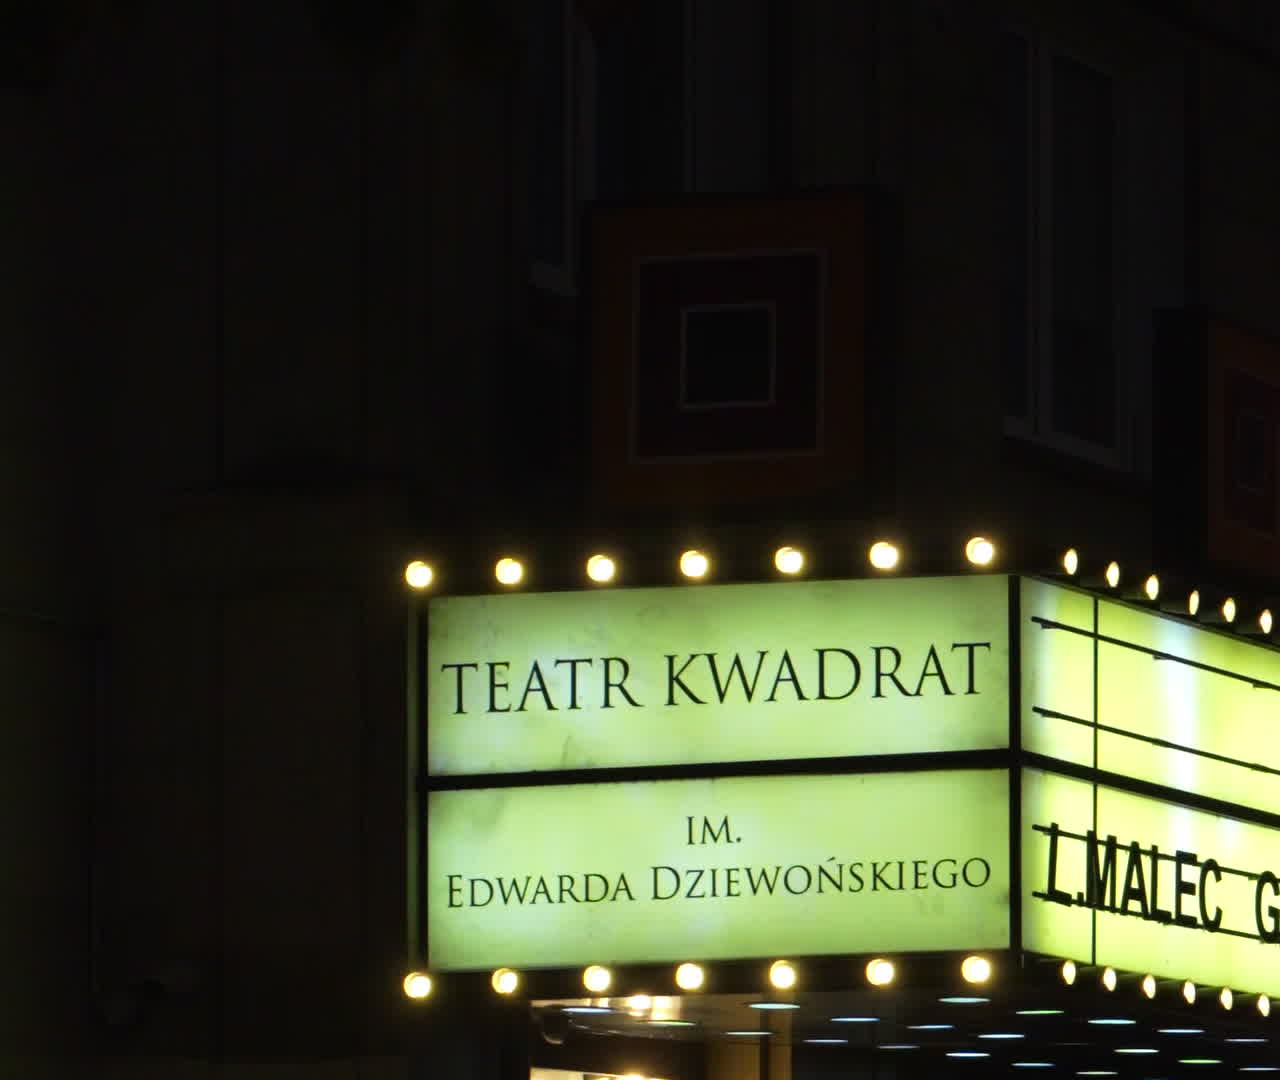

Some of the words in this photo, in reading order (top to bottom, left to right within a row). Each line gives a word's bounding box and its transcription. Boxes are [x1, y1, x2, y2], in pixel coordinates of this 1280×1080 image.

[441, 656, 644, 715] TEATR
[664, 642, 992, 707] KWADRAT
[686, 814, 742, 846] IM.
